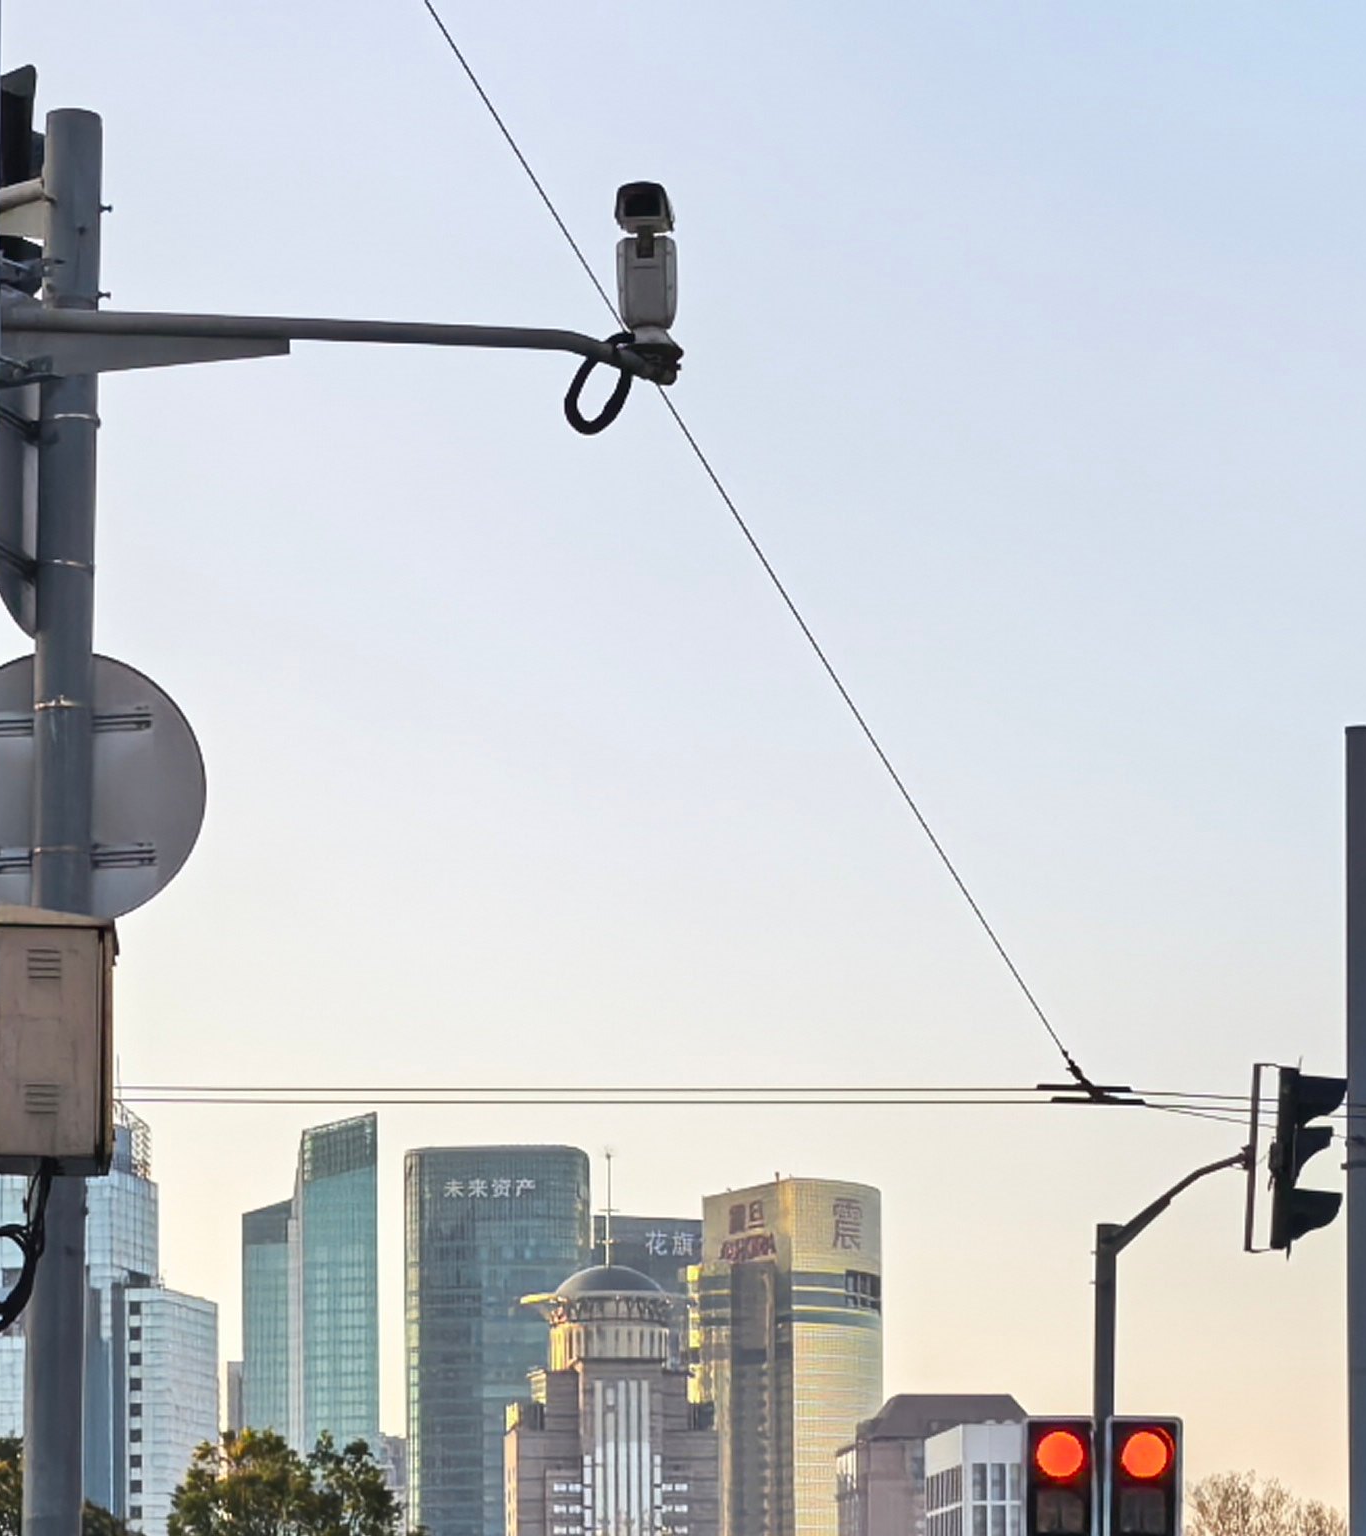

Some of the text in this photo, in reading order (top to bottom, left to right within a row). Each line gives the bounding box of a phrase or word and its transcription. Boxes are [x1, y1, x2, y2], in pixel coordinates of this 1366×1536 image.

[443, 1178, 536, 1198] 未来资产
[729, 1201, 765, 1234] 旦
[645, 1228, 704, 1256] 花旗
